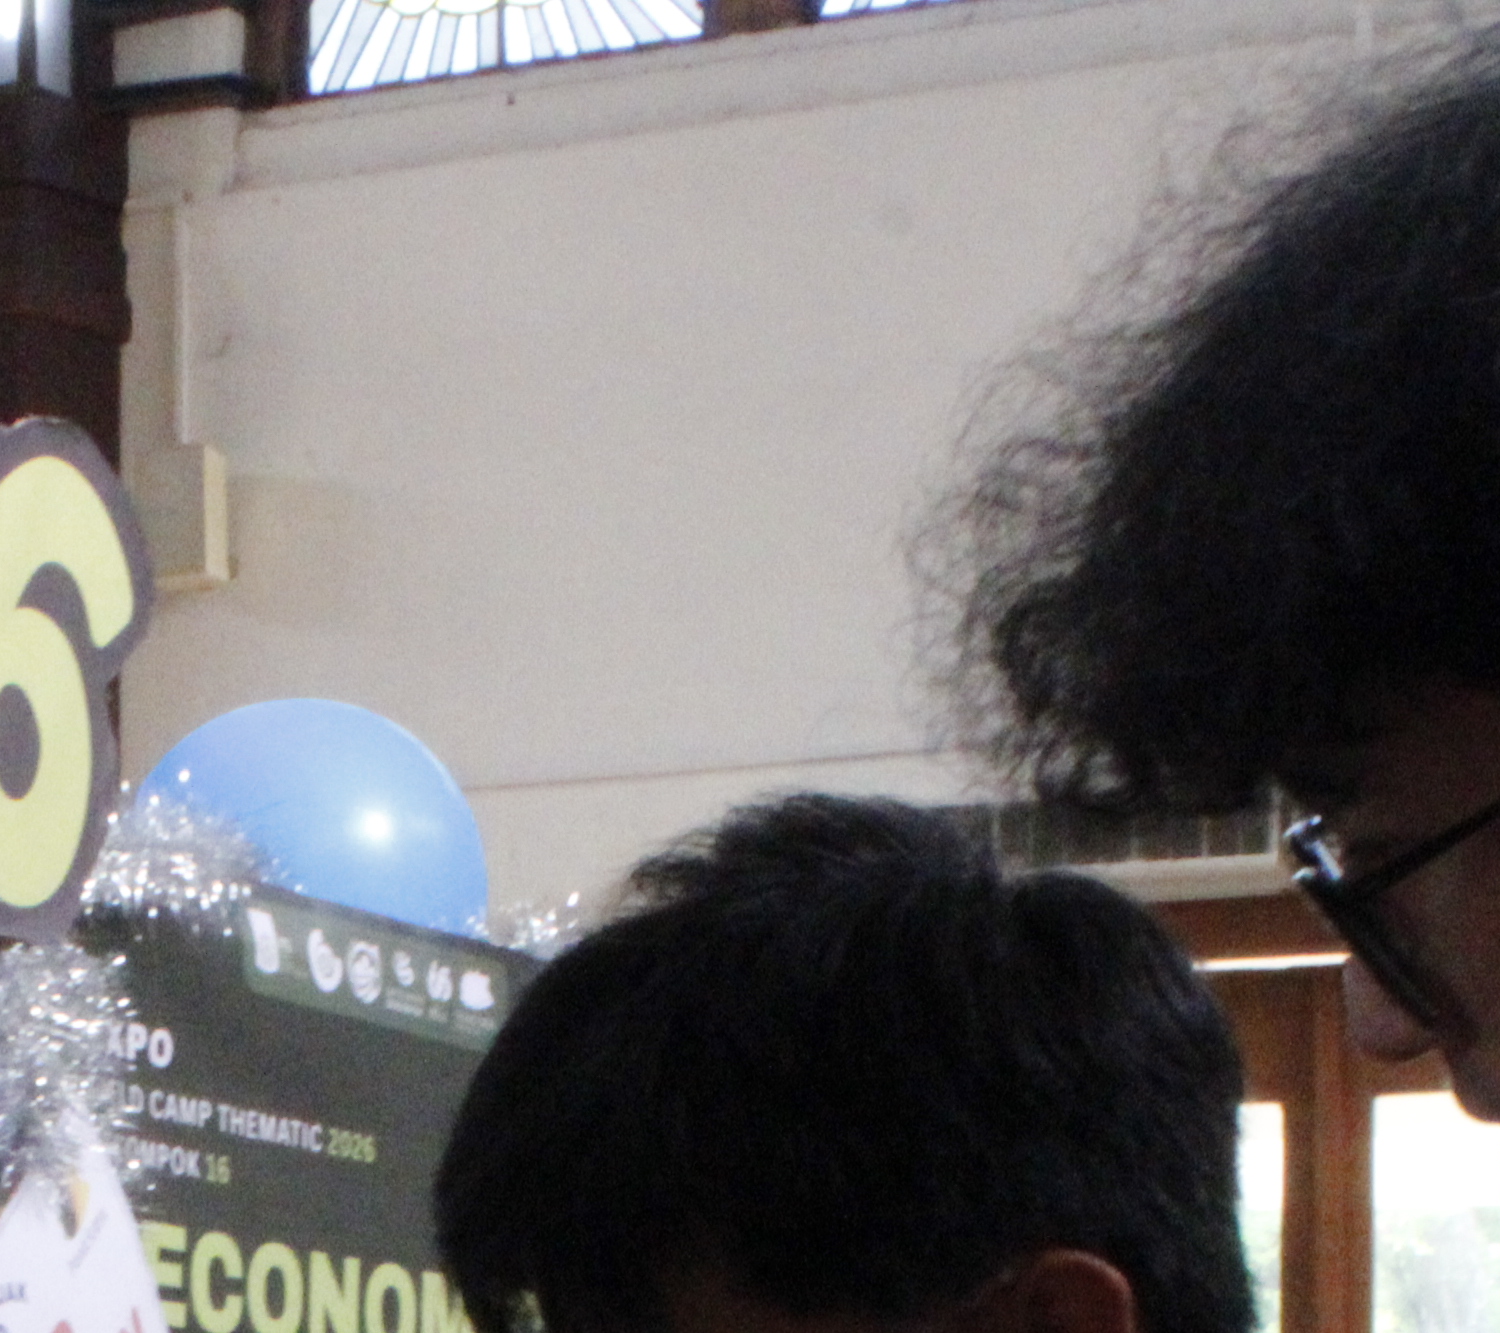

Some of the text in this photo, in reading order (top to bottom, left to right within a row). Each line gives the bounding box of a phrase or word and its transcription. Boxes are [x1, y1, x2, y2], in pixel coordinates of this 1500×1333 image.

[148, 1092, 212, 1128] CAMP
[218, 1104, 323, 1153] THEMATIC
[327, 1128, 376, 1163] 2026
[204, 1154, 231, 1185] 16
